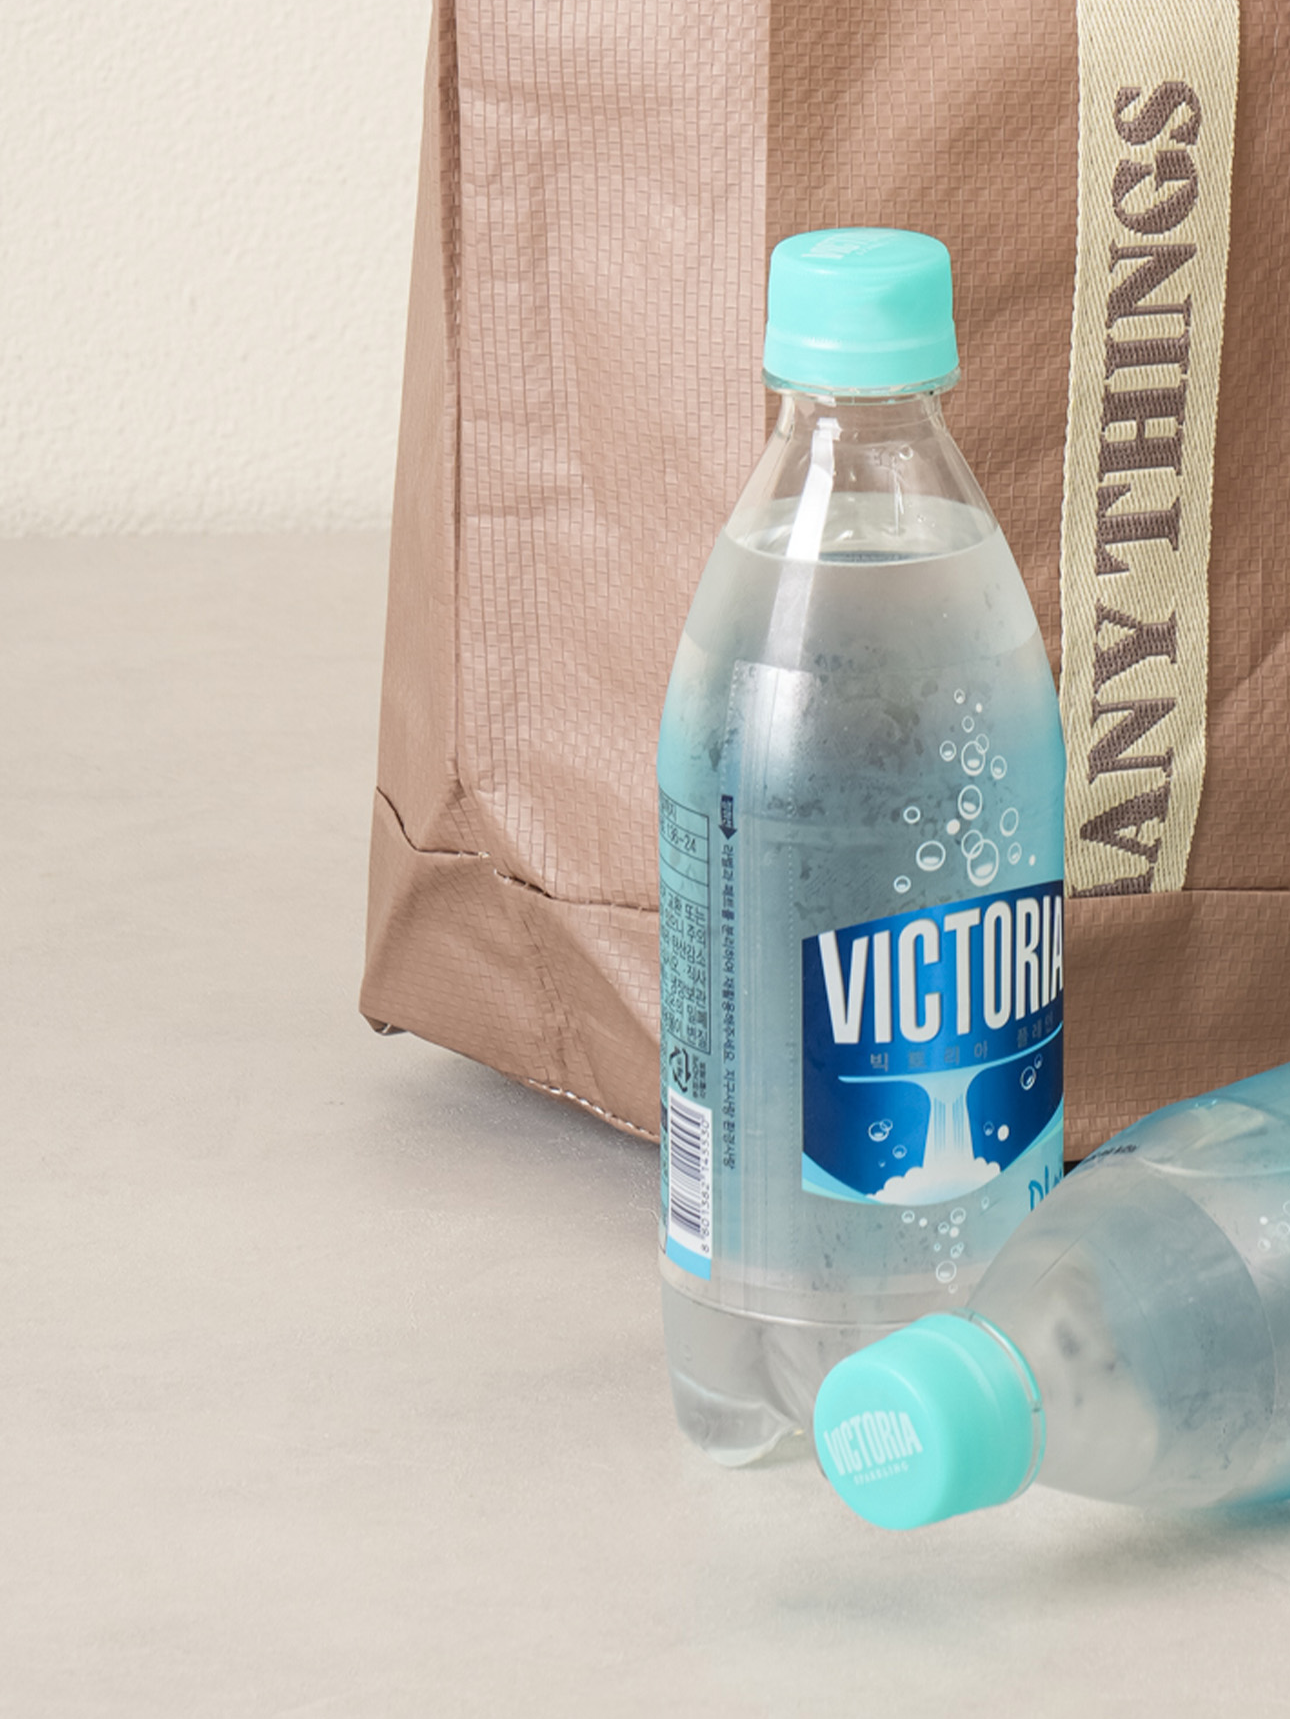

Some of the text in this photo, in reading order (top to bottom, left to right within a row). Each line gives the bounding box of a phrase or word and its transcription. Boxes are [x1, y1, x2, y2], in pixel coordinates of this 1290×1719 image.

[1072, 81, 1201, 898] ANY THINGS
[818, 894, 1063, 1045] VICTORIA
[823, 1411, 923, 1476] VICTORIA
